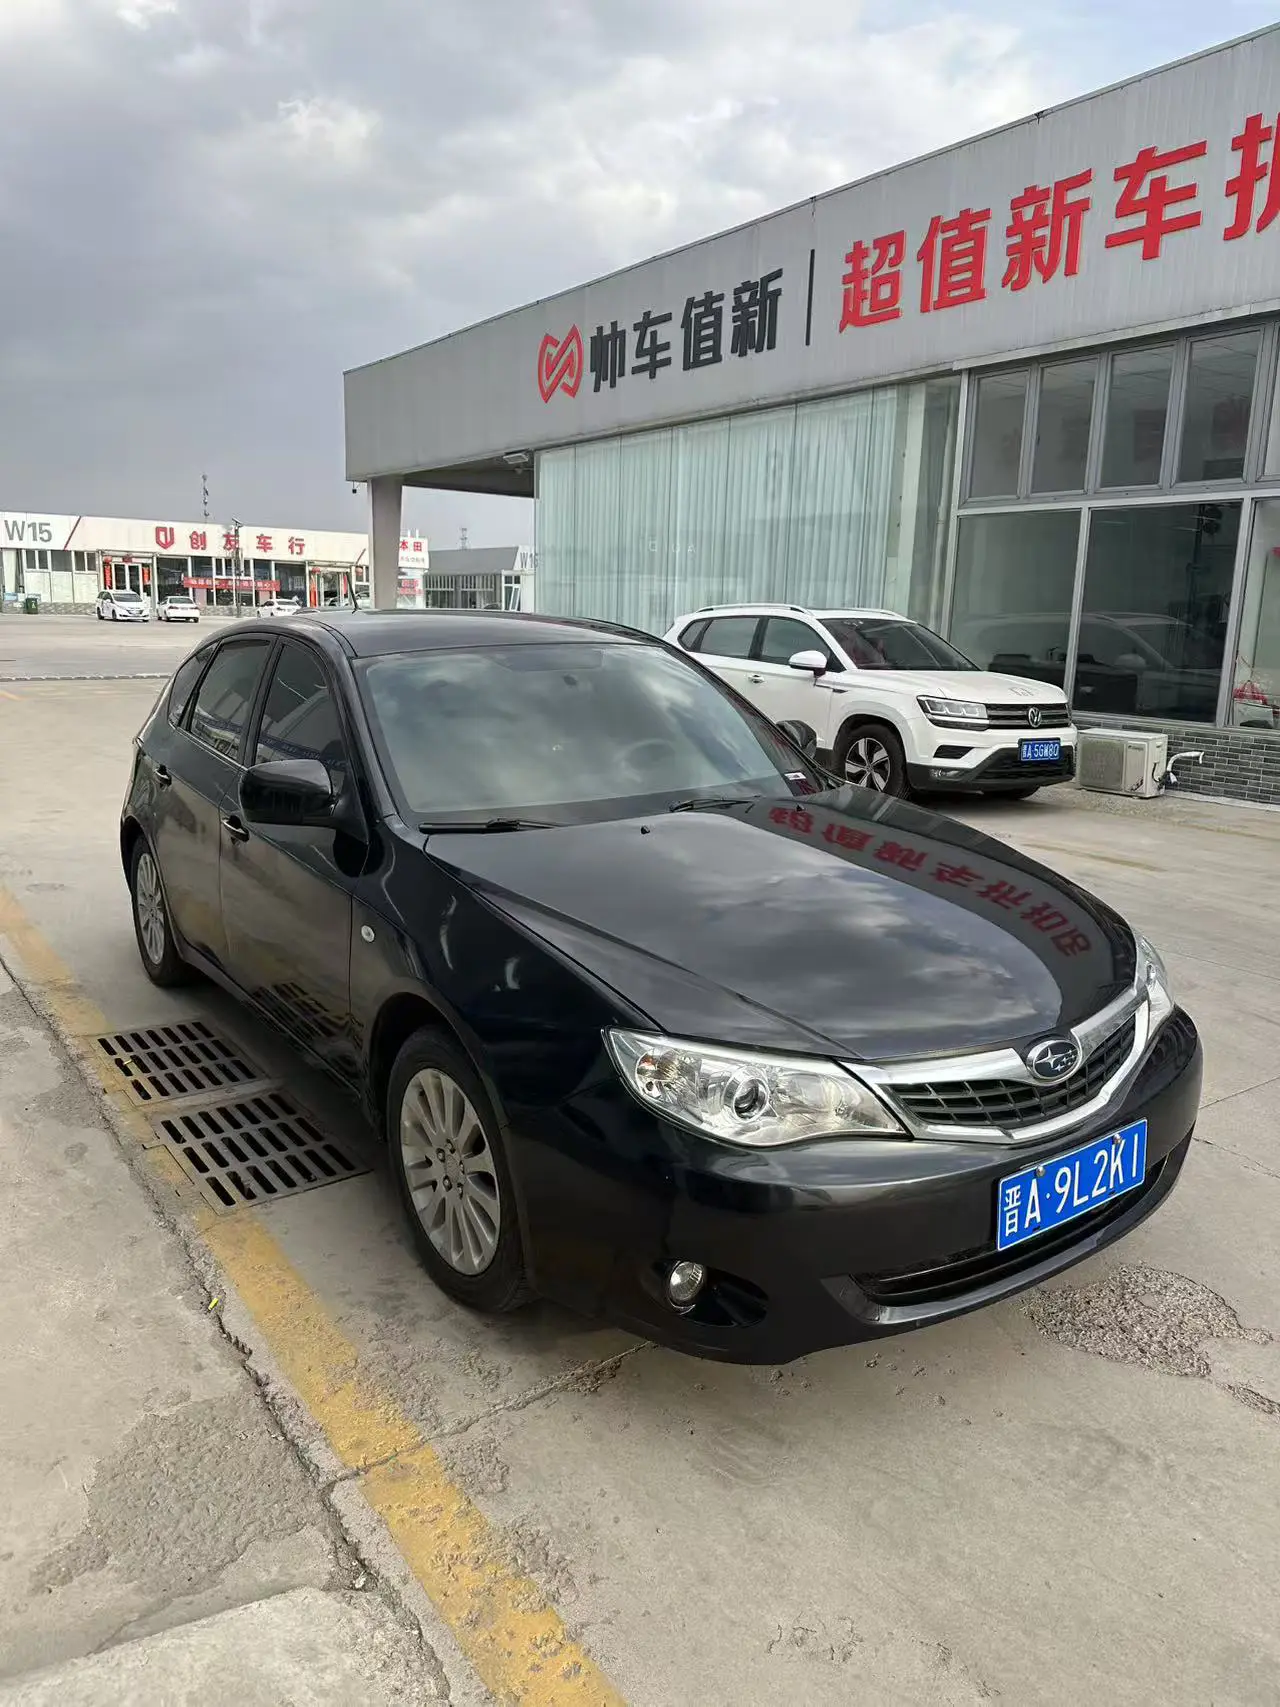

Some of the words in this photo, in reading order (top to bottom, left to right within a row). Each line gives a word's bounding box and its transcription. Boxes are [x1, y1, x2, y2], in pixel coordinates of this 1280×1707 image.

[590, 268, 783, 392] 帅车值新
[4, 519, 52, 543] W15
